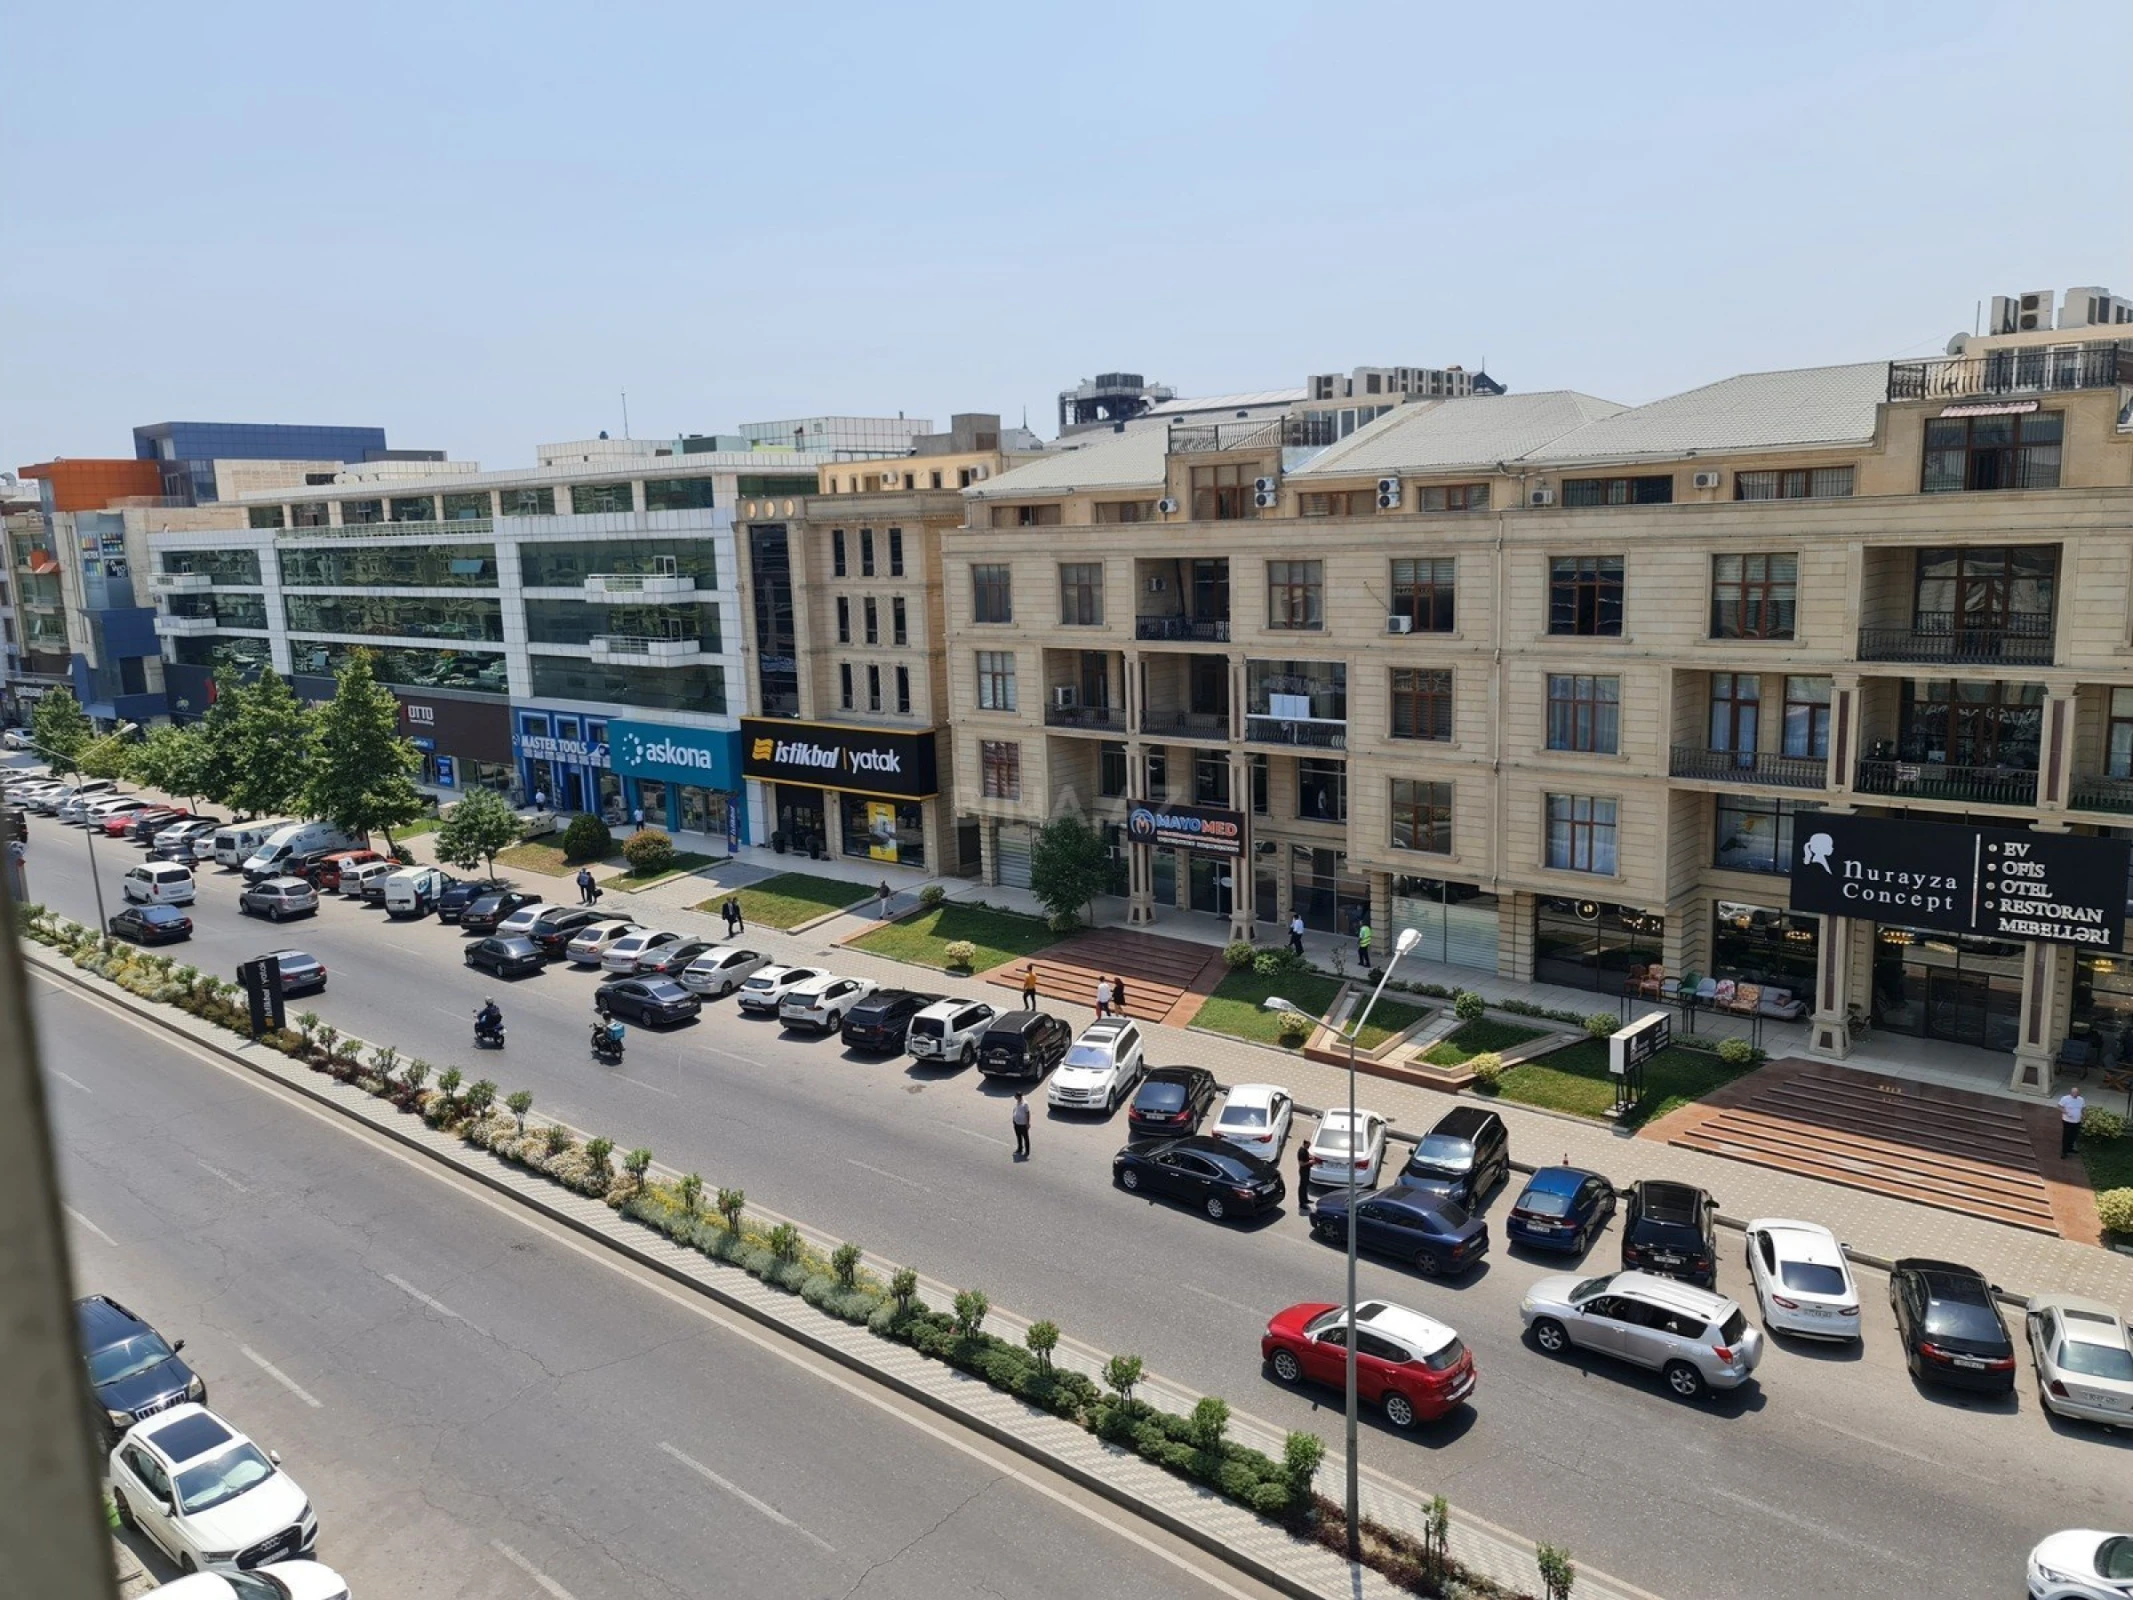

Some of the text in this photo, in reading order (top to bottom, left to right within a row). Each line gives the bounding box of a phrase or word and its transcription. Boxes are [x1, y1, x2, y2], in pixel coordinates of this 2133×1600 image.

[407, 705, 434, 721] OTTO
[521, 735, 588, 755] MASTER TOOLS
[645, 737, 712, 769] askona
[774, 740, 901, 774] istikbal yatak
[1156, 813, 1239, 837] MAYOMED
[2002, 842, 2031, 857] EV
[1842, 882, 1953, 912] Concept
[2000, 879, 2053, 898] OTEL
[1999, 898, 2104, 923] RESTORAN
